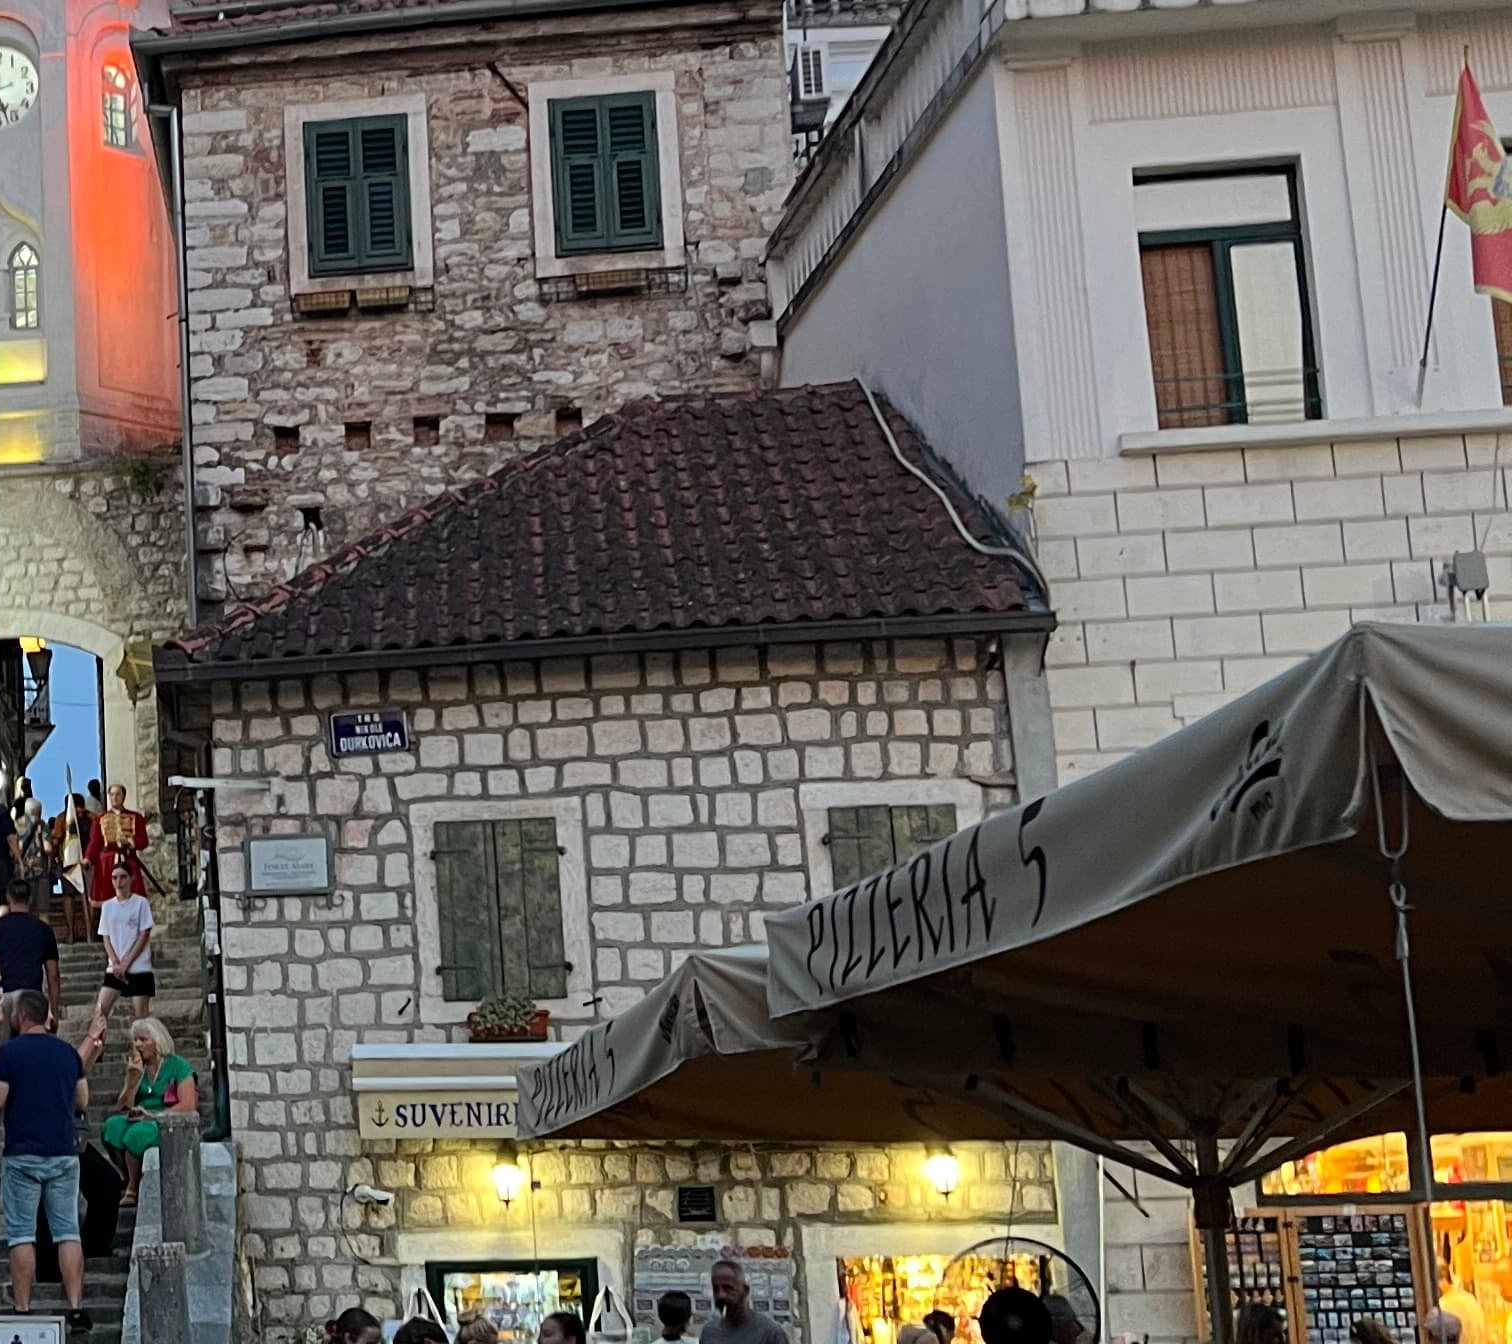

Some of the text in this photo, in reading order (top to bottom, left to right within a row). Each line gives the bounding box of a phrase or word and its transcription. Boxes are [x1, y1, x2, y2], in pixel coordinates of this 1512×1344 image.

[10, 55, 15, 69] 1
[20, 66, 29, 79] 2
[25, 81, 35, 94] 3
[20, 98, 29, 110] 4
[9, 110, 19, 123] 5
[807, 797, 1047, 995] PIZZERIA 5
[531, 1020, 616, 1127] PIZZERIA 5
[395, 1102, 519, 1128] SUVENIRI
